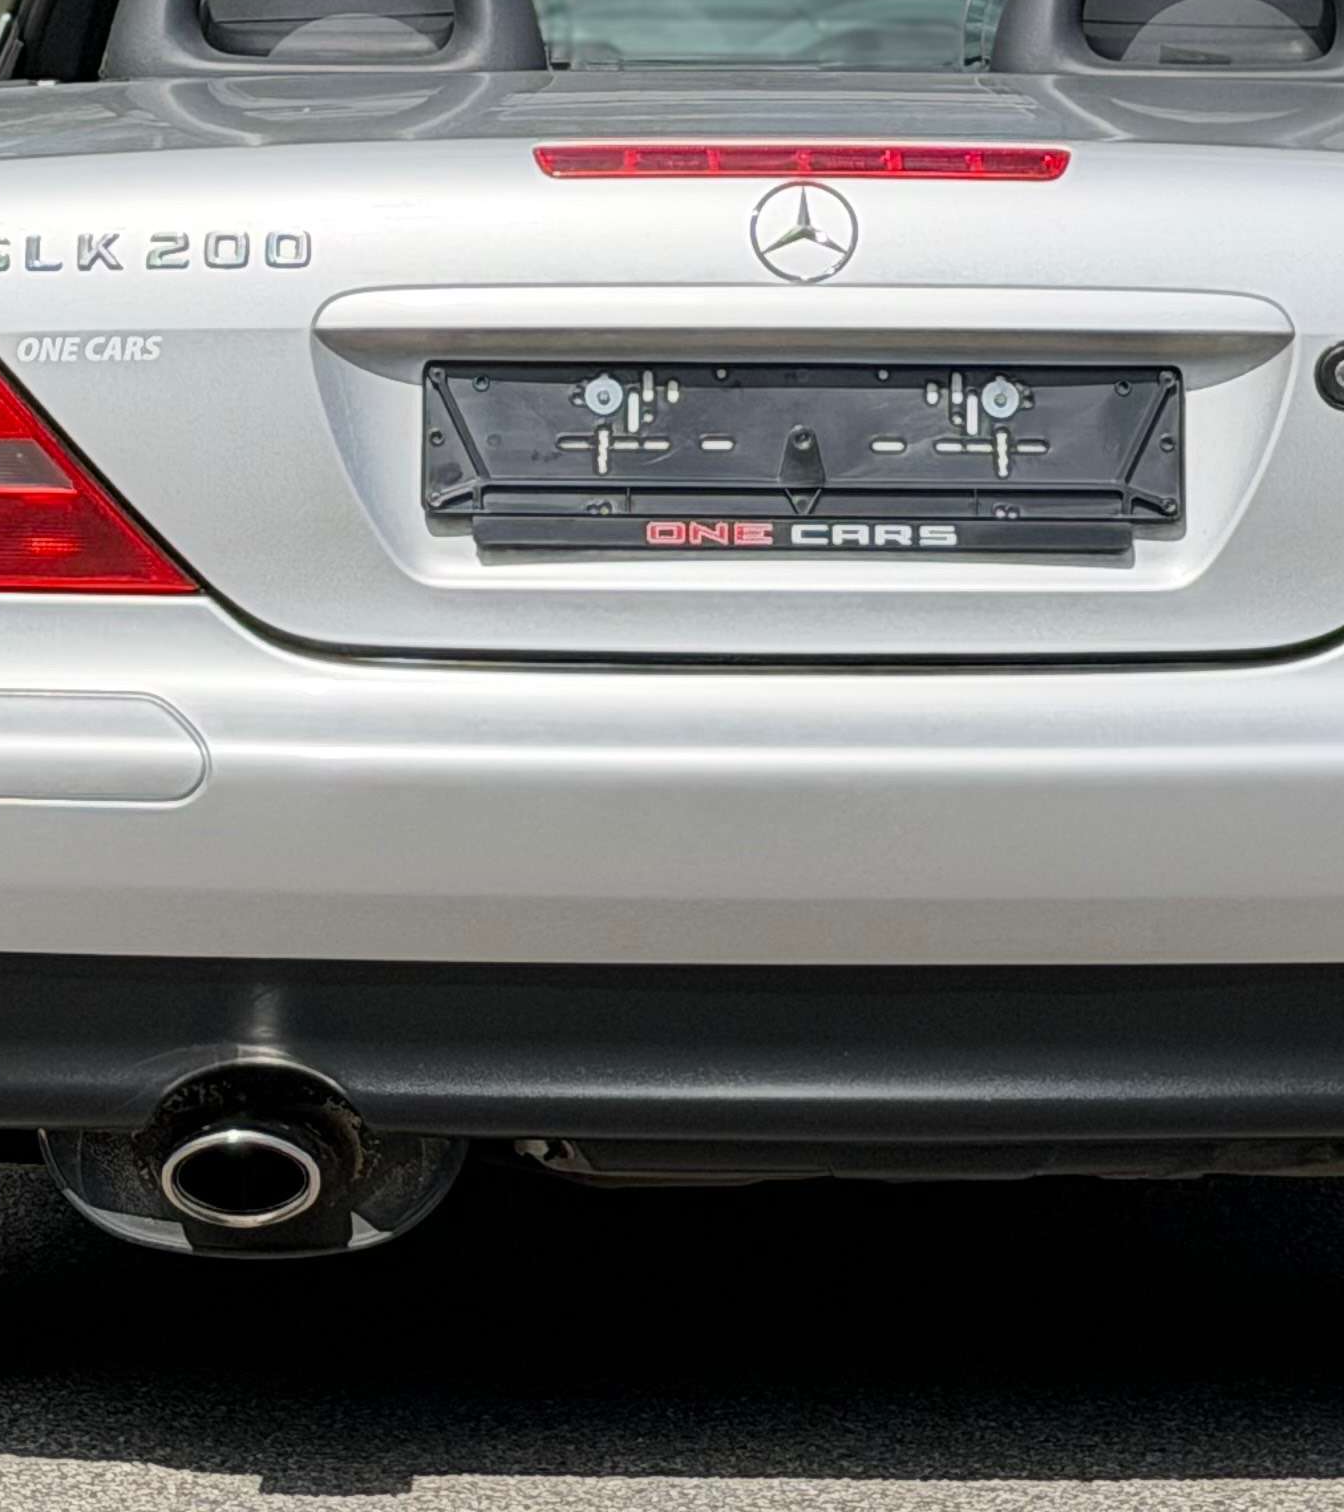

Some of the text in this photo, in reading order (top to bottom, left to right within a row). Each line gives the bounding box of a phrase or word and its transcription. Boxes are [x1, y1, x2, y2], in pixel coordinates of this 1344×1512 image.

[145, 230, 312, 270] 200
[16, 335, 163, 363] ONE CARS
[646, 520, 957, 546] ONE CARS
